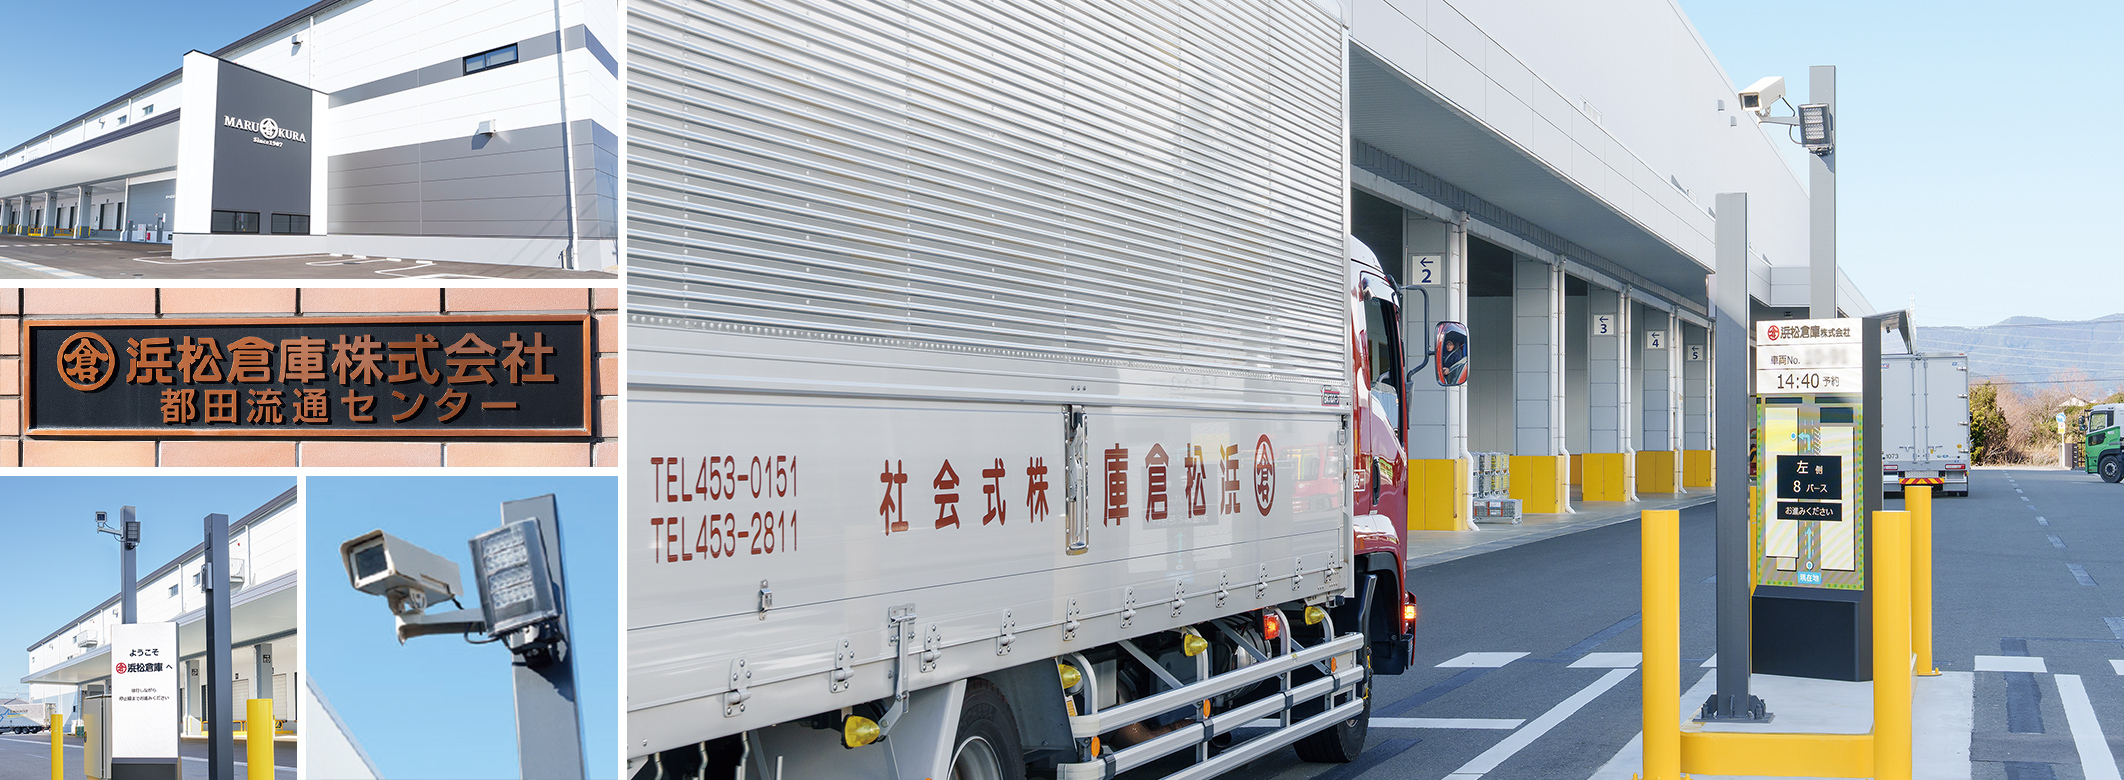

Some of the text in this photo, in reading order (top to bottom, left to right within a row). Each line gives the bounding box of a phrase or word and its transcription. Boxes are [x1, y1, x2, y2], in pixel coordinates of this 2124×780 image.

[224, 115, 260, 132] MARU
[278, 127, 306, 143] KURA
[1421, 269, 1432, 283] 2
[1600, 323, 1608, 334] 3
[1780, 325, 1851, 339] 浜松倉庫株式会社
[1652, 339, 1660, 348] 4
[126, 332, 555, 384] 浜松倉庫株式会社
[1692, 351, 1699, 360] 5
[1777, 373, 1840, 389] 14:40 予約
[160, 388, 517, 423] 都田流通センター
[650, 455, 797, 503] TEL453-0151
[1793, 480, 1828, 493] 8 バース
[1785, 506, 1834, 517] お進みください
[650, 510, 797, 564] TEL453-2811
[129, 648, 159, 657] ようこそ
[127, 662, 163, 673] 浜松倉庫
